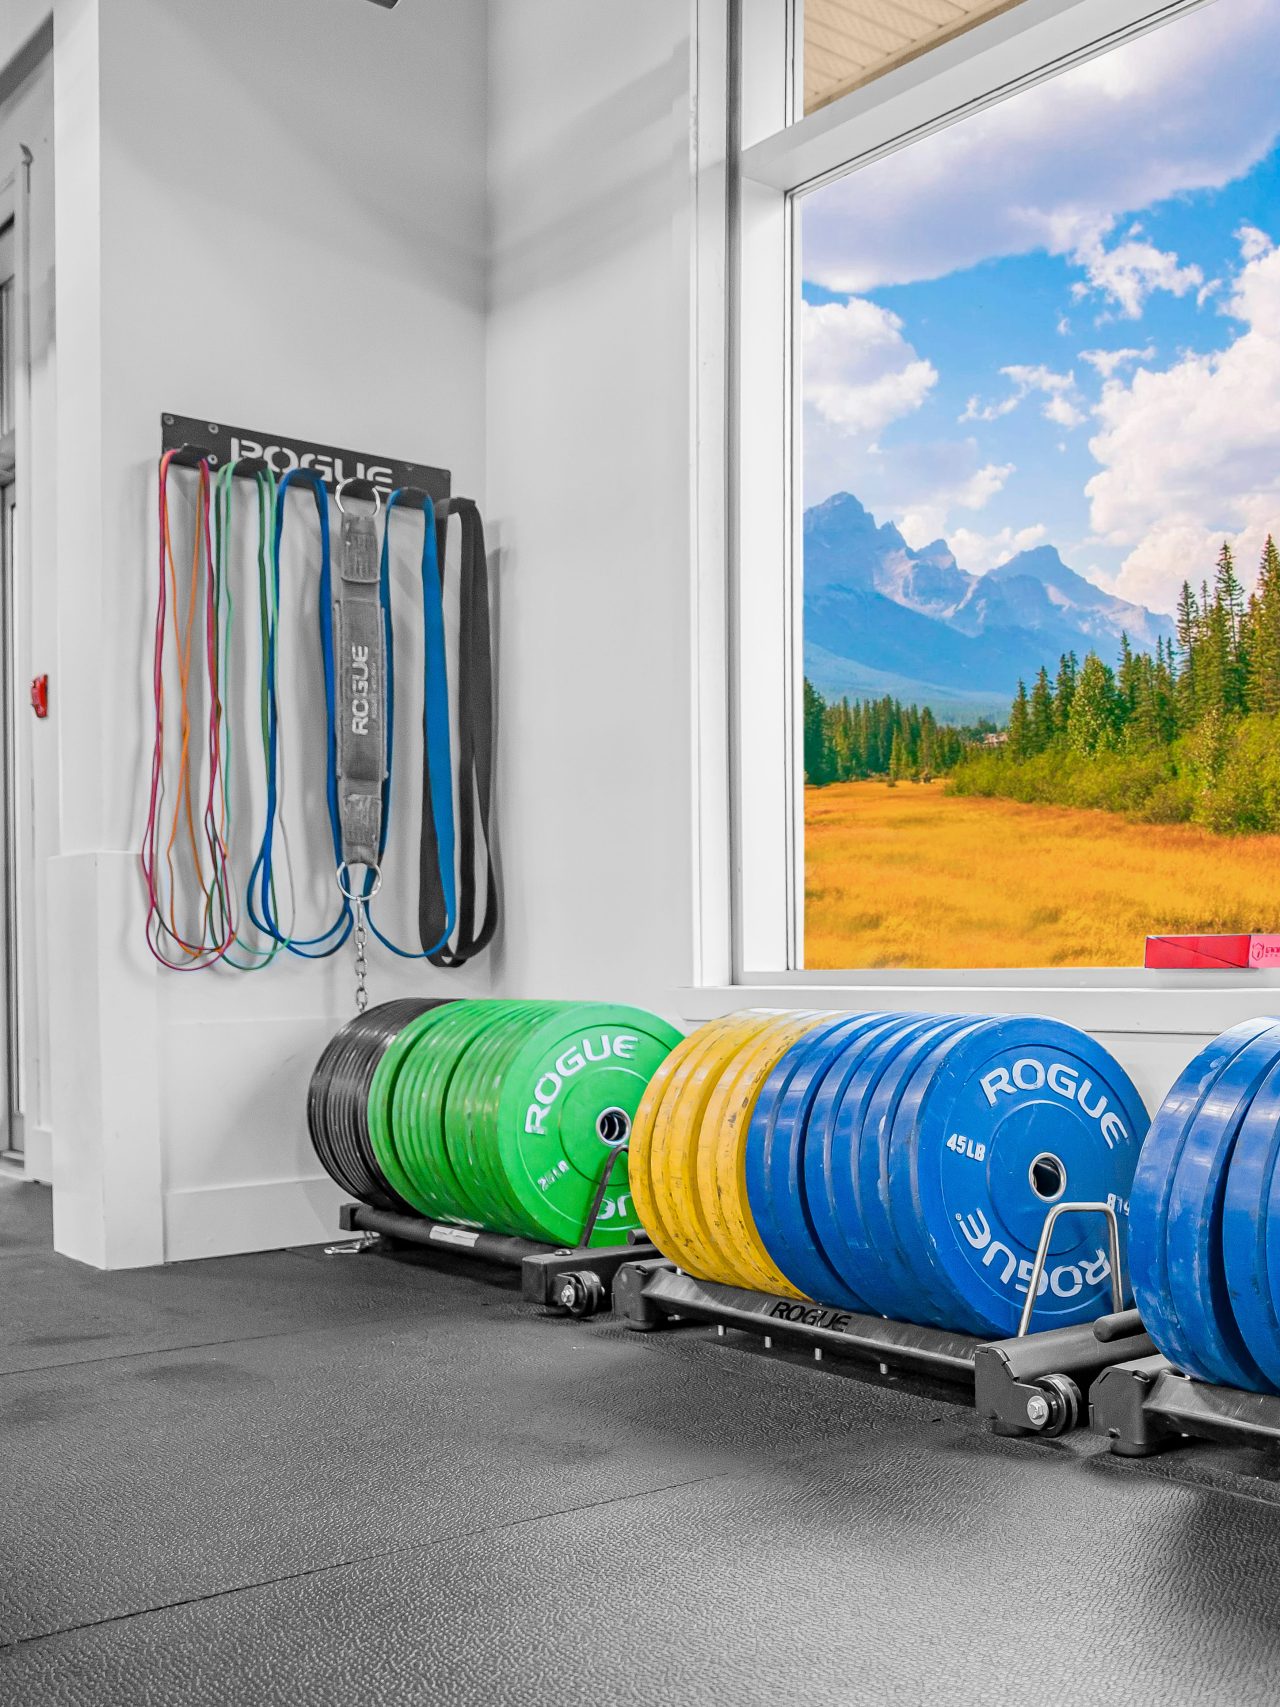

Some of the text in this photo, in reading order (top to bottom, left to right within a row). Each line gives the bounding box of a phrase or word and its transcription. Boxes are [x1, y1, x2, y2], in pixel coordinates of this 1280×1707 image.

[230, 437, 392, 493] ROGUE
[351, 643, 369, 735] ROGUE
[525, 1034, 638, 1135] ROGUE
[979, 1058, 1128, 1149] ROGUE
[946, 1134, 986, 1162] 45LB
[959, 1207, 1111, 1297] ROGUE
[770, 1301, 852, 1333] ROGUE
